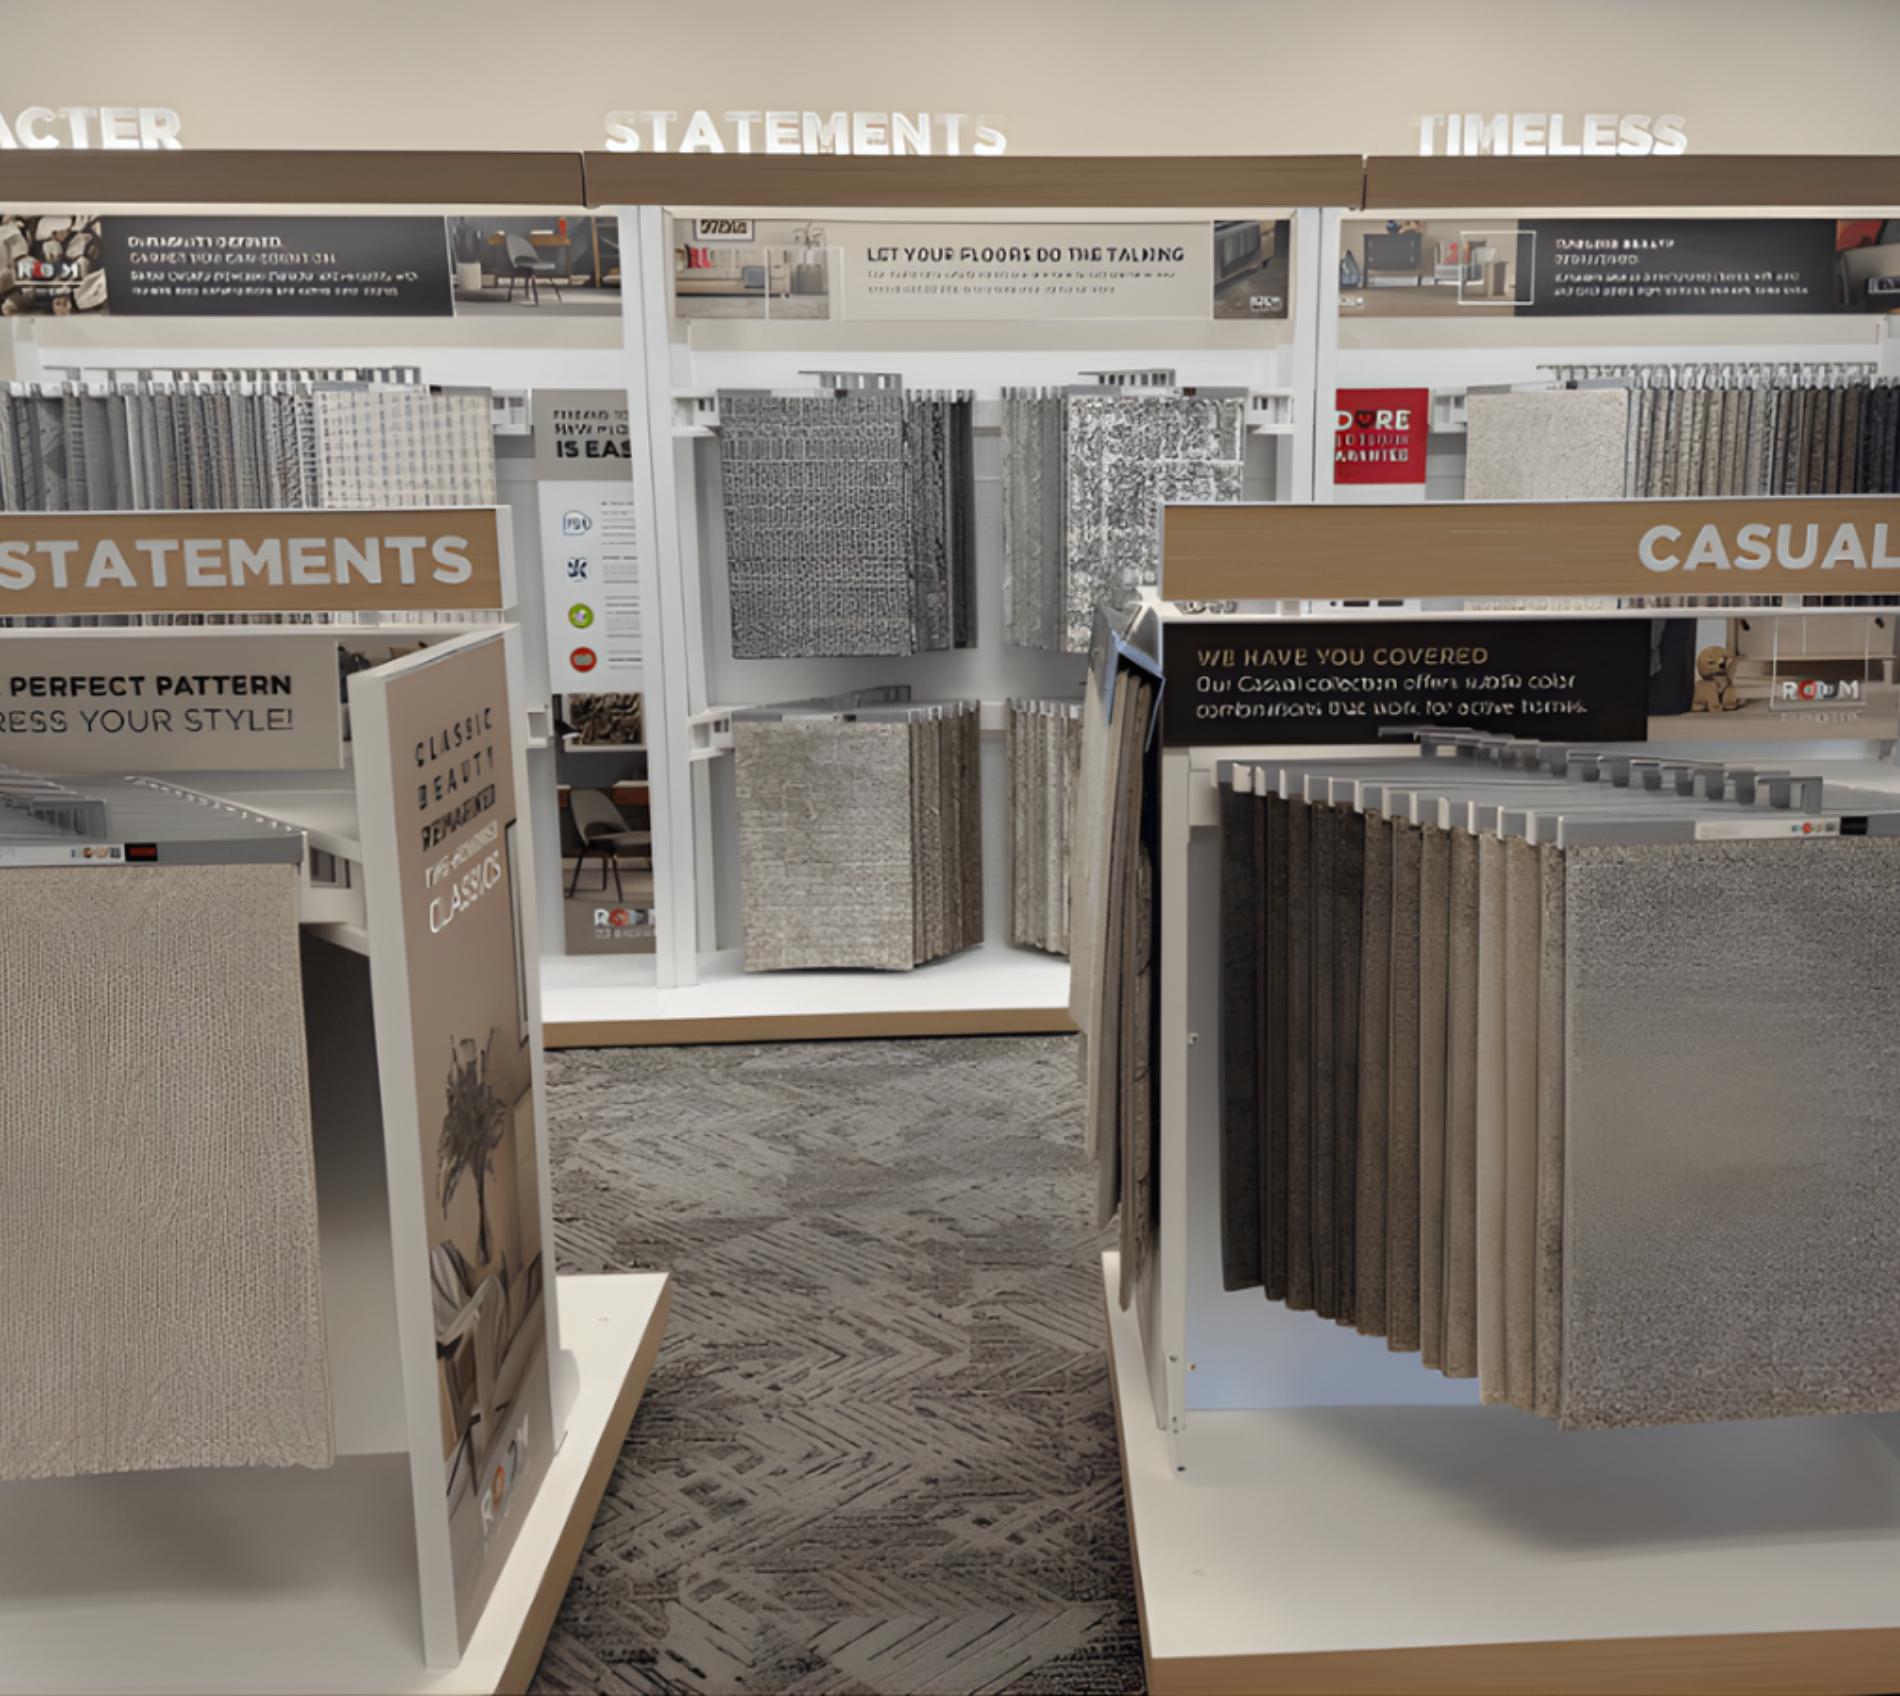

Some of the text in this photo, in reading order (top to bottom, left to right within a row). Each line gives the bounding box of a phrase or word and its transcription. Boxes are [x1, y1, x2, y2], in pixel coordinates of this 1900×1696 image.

[604, 110, 1008, 156] STATEMENTS
[1413, 113, 1689, 156] TIMELESS
[557, 440, 579, 458] IS
[0, 535, 473, 591] STATEMENTS
[1638, 523, 1900, 572] CASUAL
[1198, 647, 1488, 667] WE HAVE YOU COVERED
[10, 675, 292, 697] PERFECT PATTERN
[79, 709, 173, 733] YOUR
[184, 708, 294, 732] STYLE!
[415, 707, 493, 768] CLASSIC
